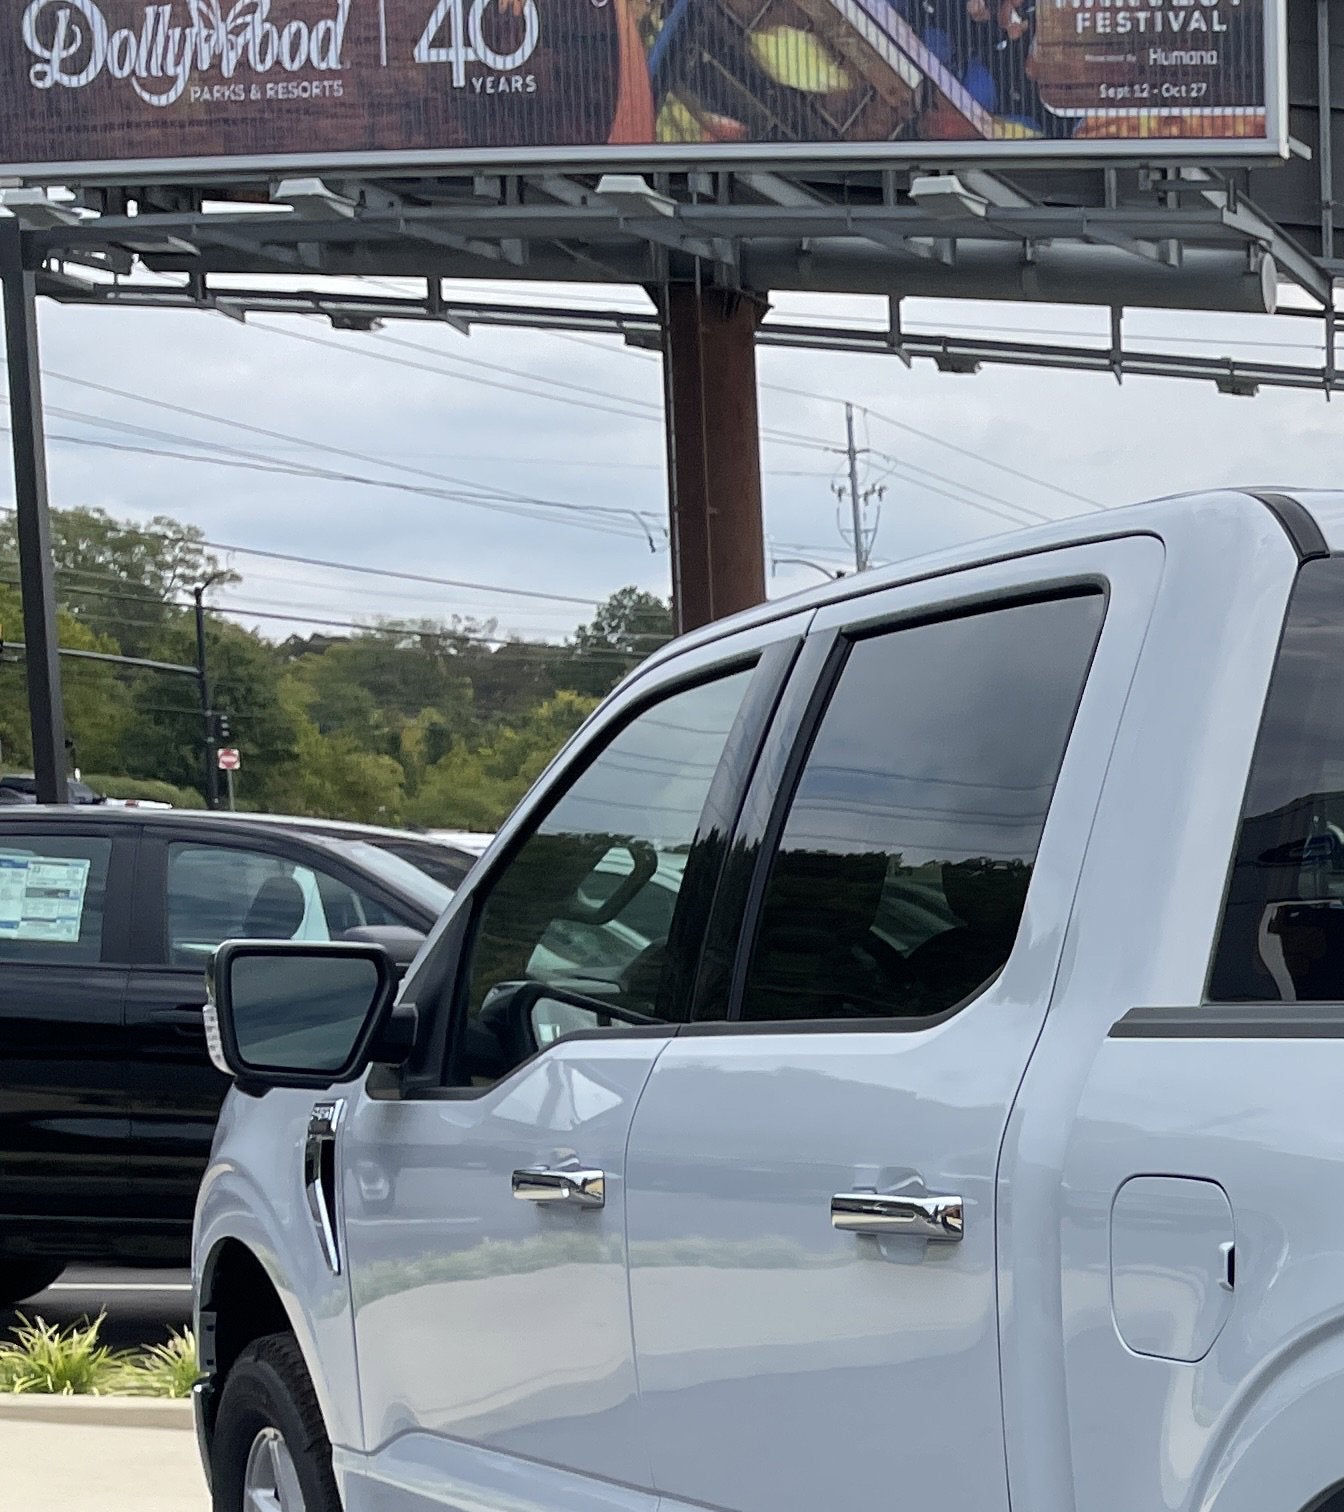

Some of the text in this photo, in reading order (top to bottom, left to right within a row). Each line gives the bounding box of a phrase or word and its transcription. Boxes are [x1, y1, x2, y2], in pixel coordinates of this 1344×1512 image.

[1076, 9, 1228, 34] FESTIVAL
[413, 0, 539, 88] 40
[1148, 48, 1218, 66] Humana
[190, 80, 344, 102] PARKS & RESORTS
[472, 74, 537, 94] YEARS
[1099, 83, 1131, 100] Sept
[1134, 83, 1149, 98] 12
[1161, 82, 1187, 98] Oct
[1189, 82, 1208, 98] 27
